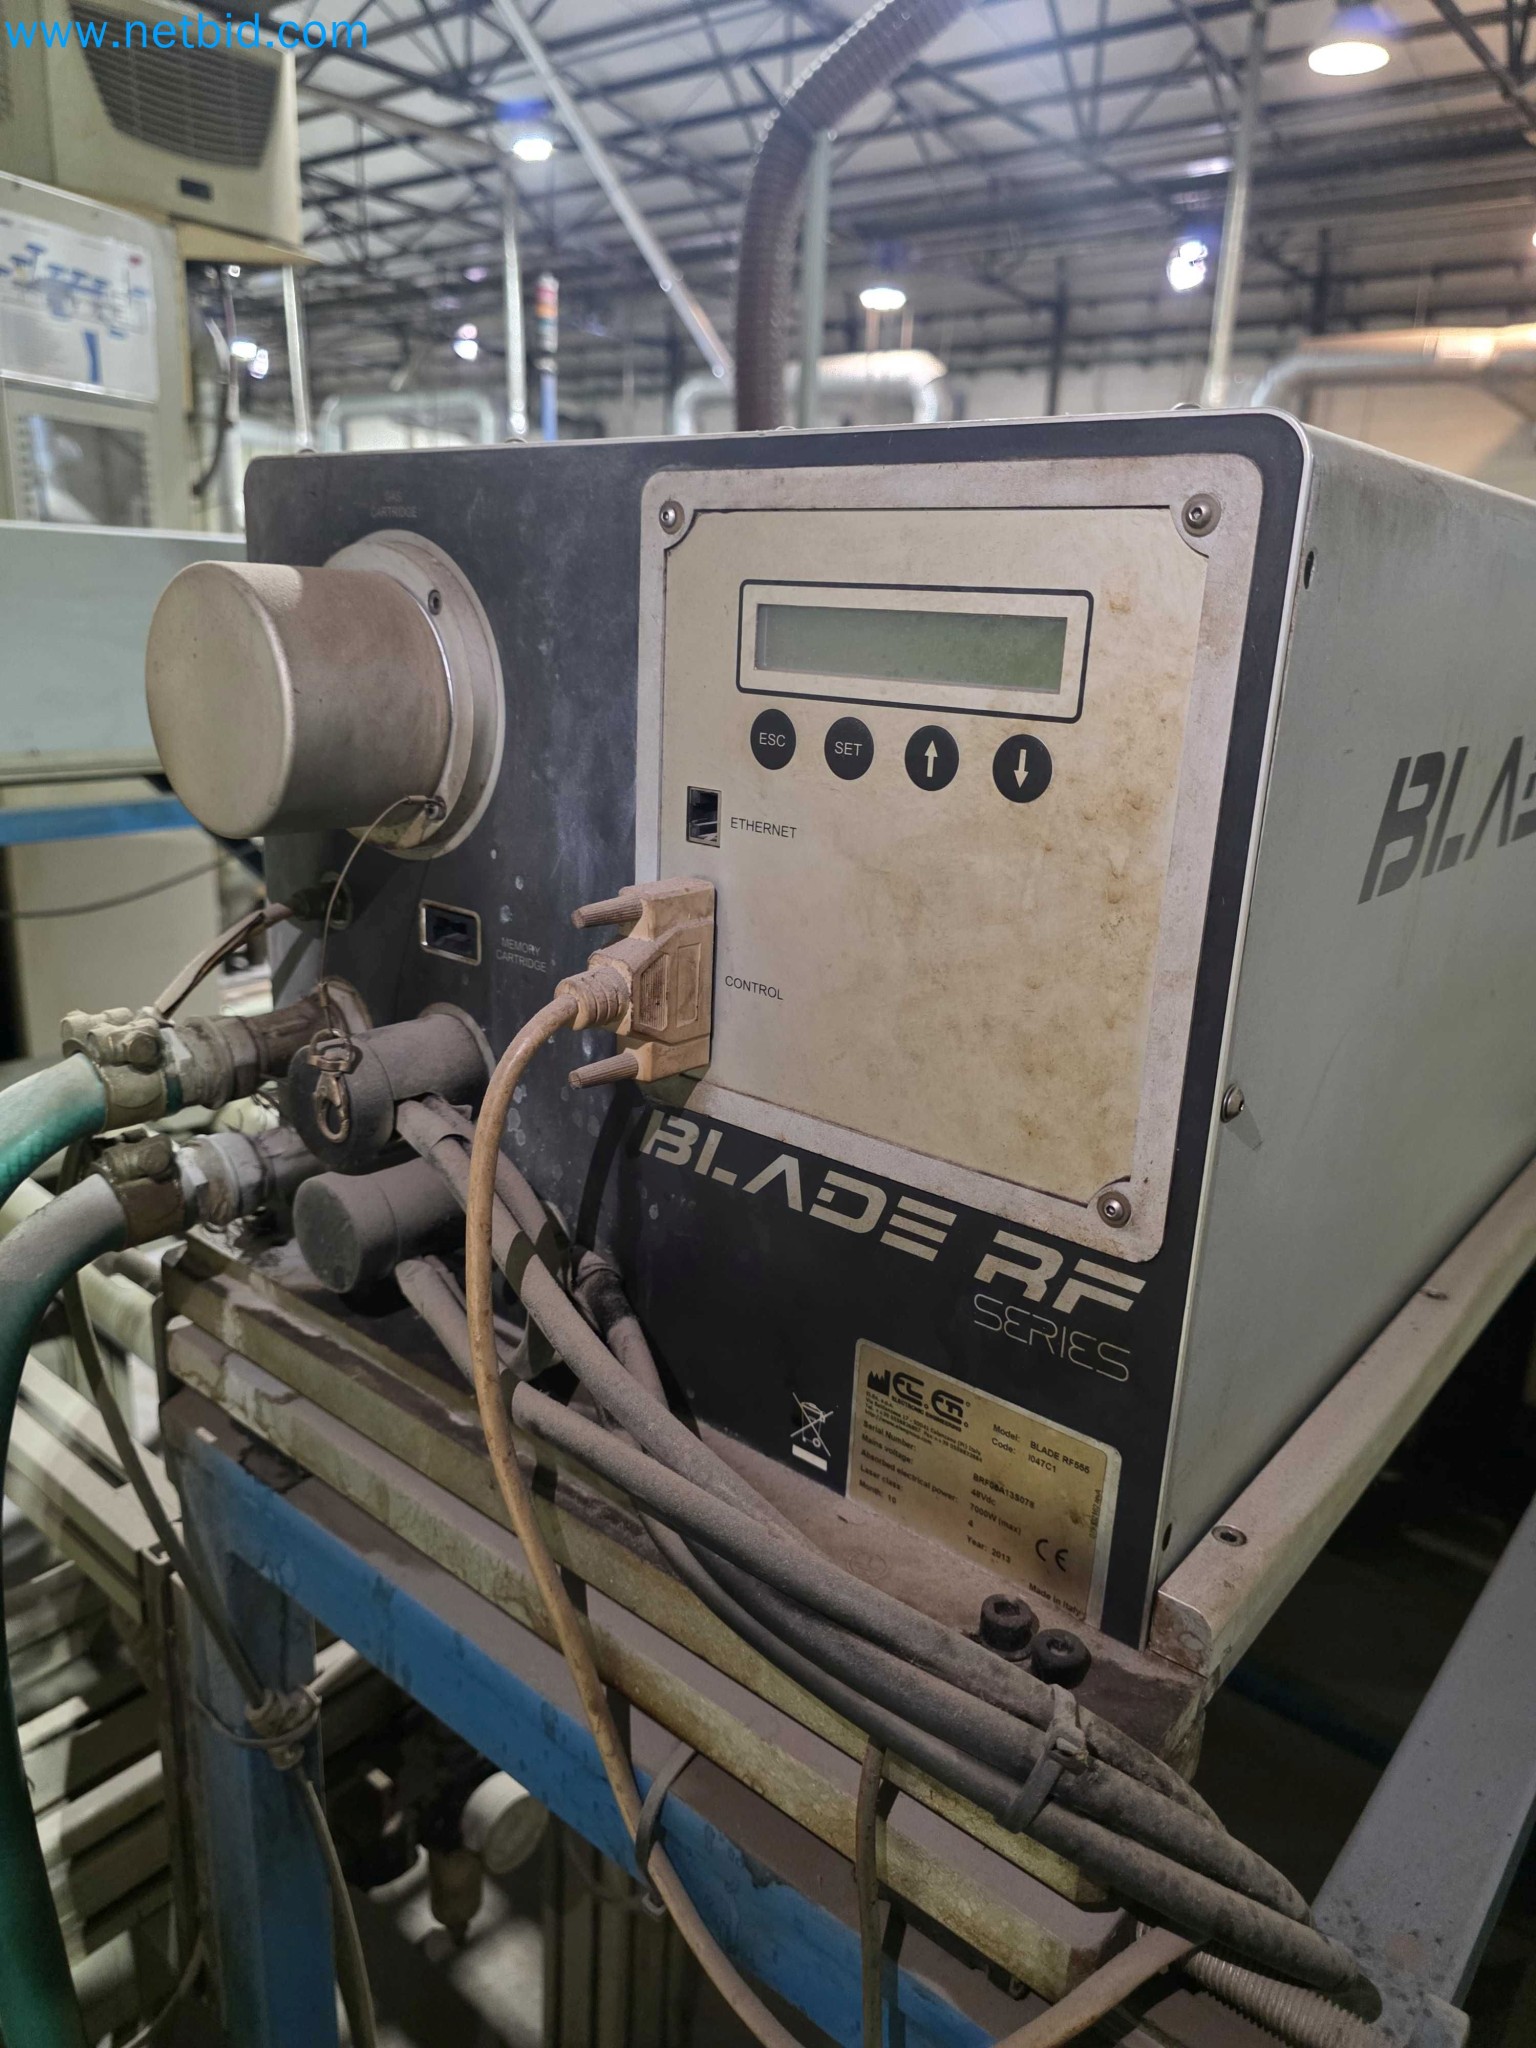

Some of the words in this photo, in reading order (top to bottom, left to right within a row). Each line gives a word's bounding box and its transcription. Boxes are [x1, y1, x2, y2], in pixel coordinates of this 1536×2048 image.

[758, 732, 786, 748] ESC
[834, 741, 862, 757] SET
[730, 817, 797, 839] ETHERNET
[496, 949, 547, 972] CARTRIDGE
[501, 937, 541, 955] MEMORY
[725, 975, 783, 1000] CONTROL
[640, 1109, 957, 1262] BLADE
[973, 1230, 1146, 1313] RF
[973, 1293, 1131, 1382] SERIES
[863, 1421, 884, 1435] Serial
[885, 1431, 916, 1451] Number:
[992, 1438, 1016, 1454] Code:
[993, 1424, 1020, 1442] Model:
[1030, 1441, 1060, 1460] BLADE
[1062, 1454, 1090, 1474] RF555
[862, 1434, 883, 1450] Mains
[884, 1444, 914, 1464] voltage:
[971, 1489, 996, 1505] 48Vdc
[860, 1449, 896, 1471] Absorbed
[897, 1466, 931, 1489] electrical
[932, 1486, 959, 1503] power:
[970, 1503, 998, 1522] 7000W
[998, 1518, 1021, 1534] (max)
[860, 1465, 880, 1479] Laser
[882, 1475, 903, 1491] class:
[968, 1520, 974, 1528] 4
[859, 1480, 883, 1497] Month:
[887, 1495, 897, 1504] 10
[967, 1535, 987, 1551] Year:
[991, 1548, 1011, 1563] 2013
[1029, 1583, 1051, 1601] Made
[1053, 1596, 1061, 1606] in
[1063, 1600, 1081, 1617] Italy
